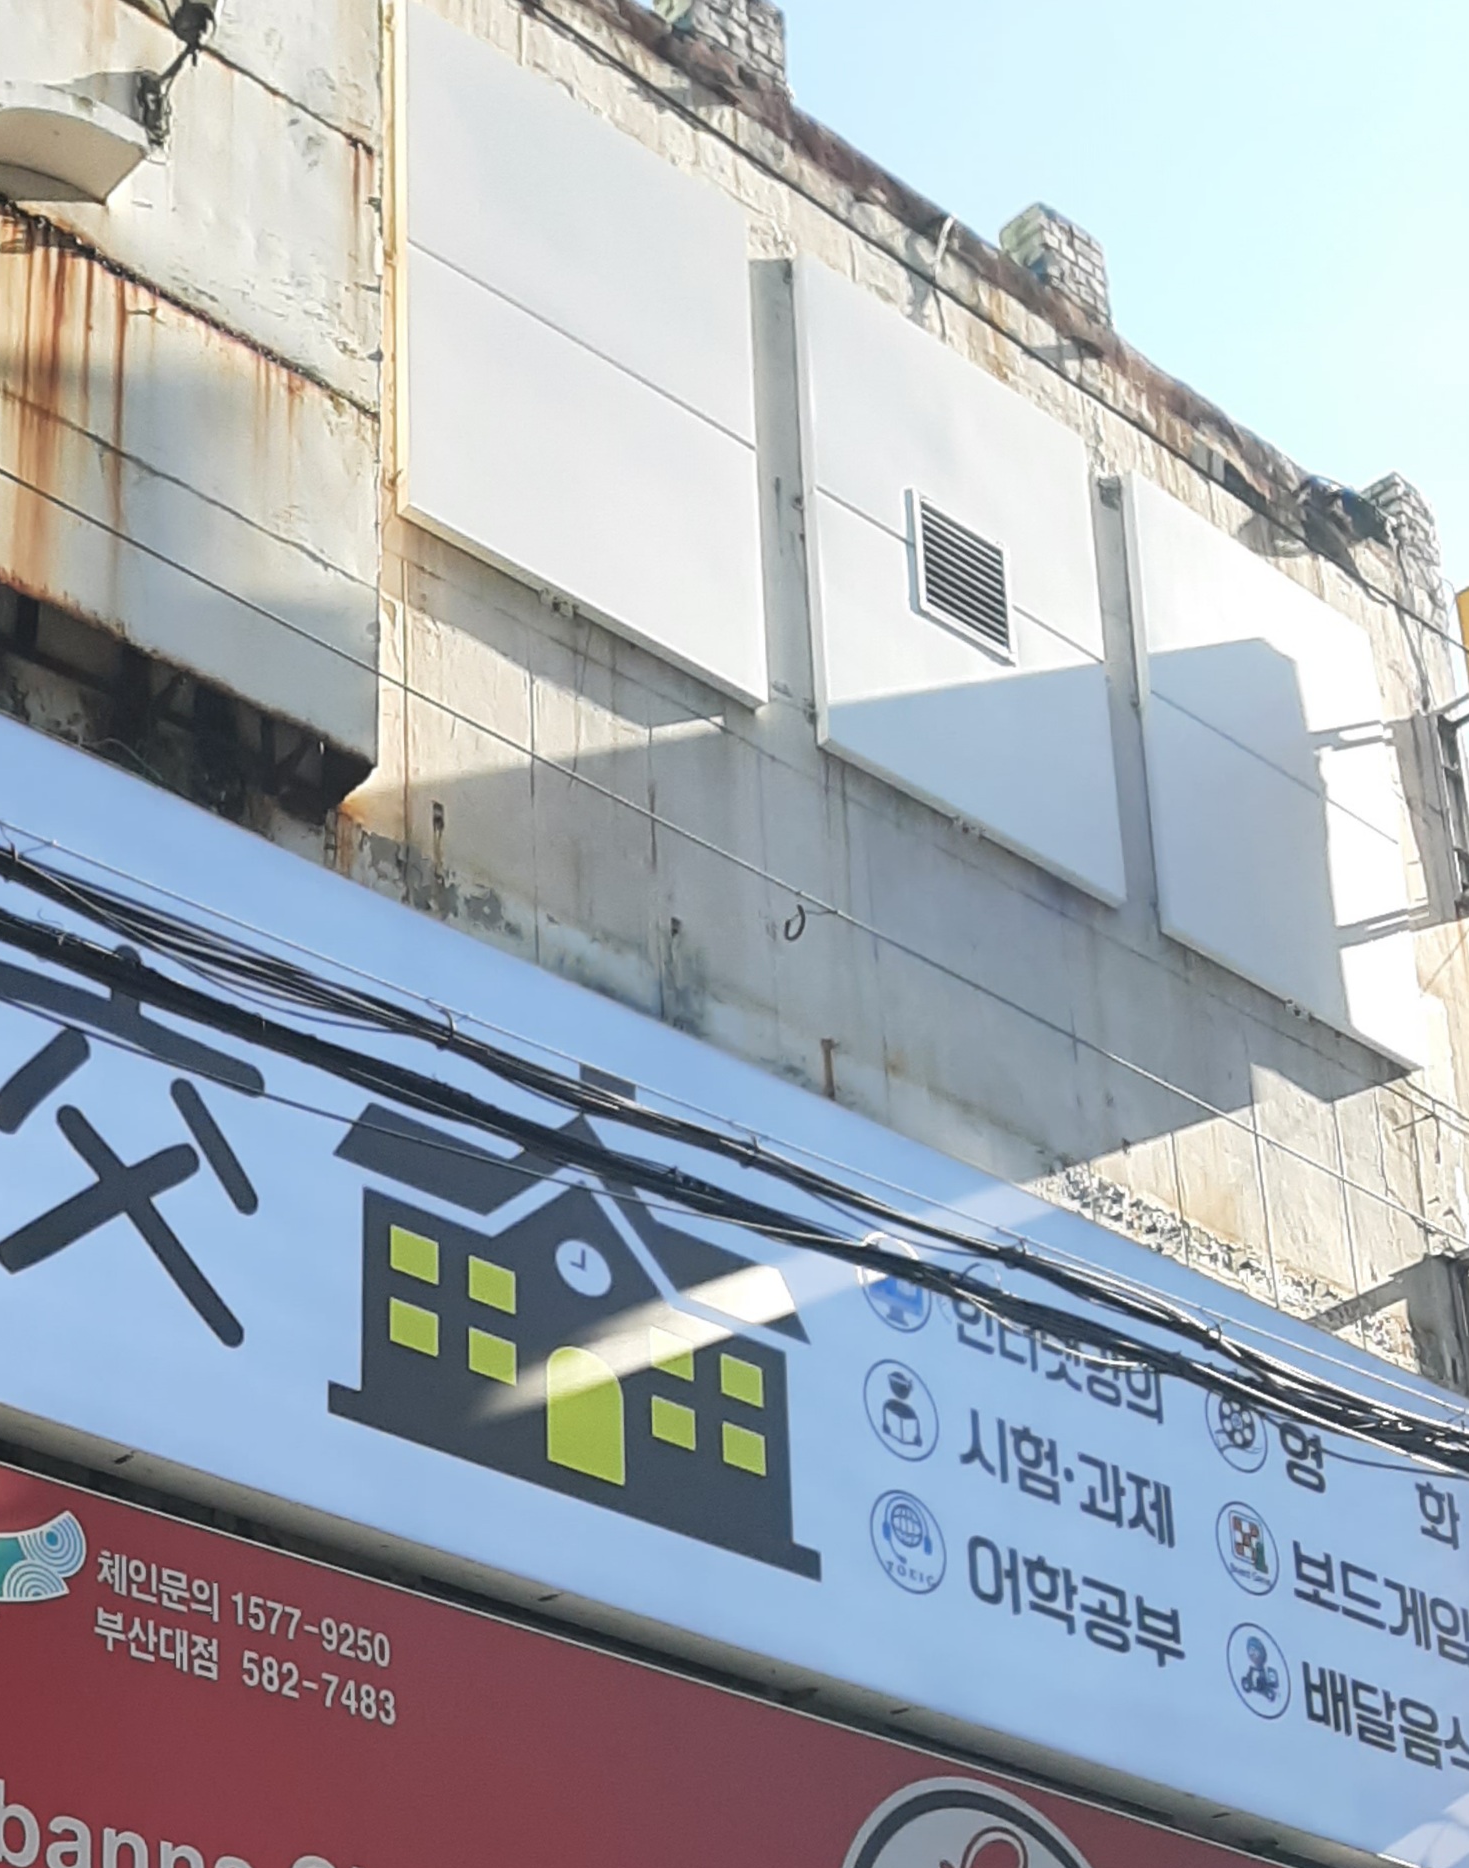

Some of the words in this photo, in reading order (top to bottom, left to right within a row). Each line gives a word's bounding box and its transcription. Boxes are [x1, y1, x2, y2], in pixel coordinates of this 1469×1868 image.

[95, 1548, 220, 1622] 체인문의
[231, 1590, 391, 1669] 1577-9250
[968, 1535, 1185, 1668] 어학공부
[1292, 1540, 1469, 1665] 보드게임
[93, 1606, 220, 1681] 부산대점
[241, 1649, 397, 1726] 582-7483
